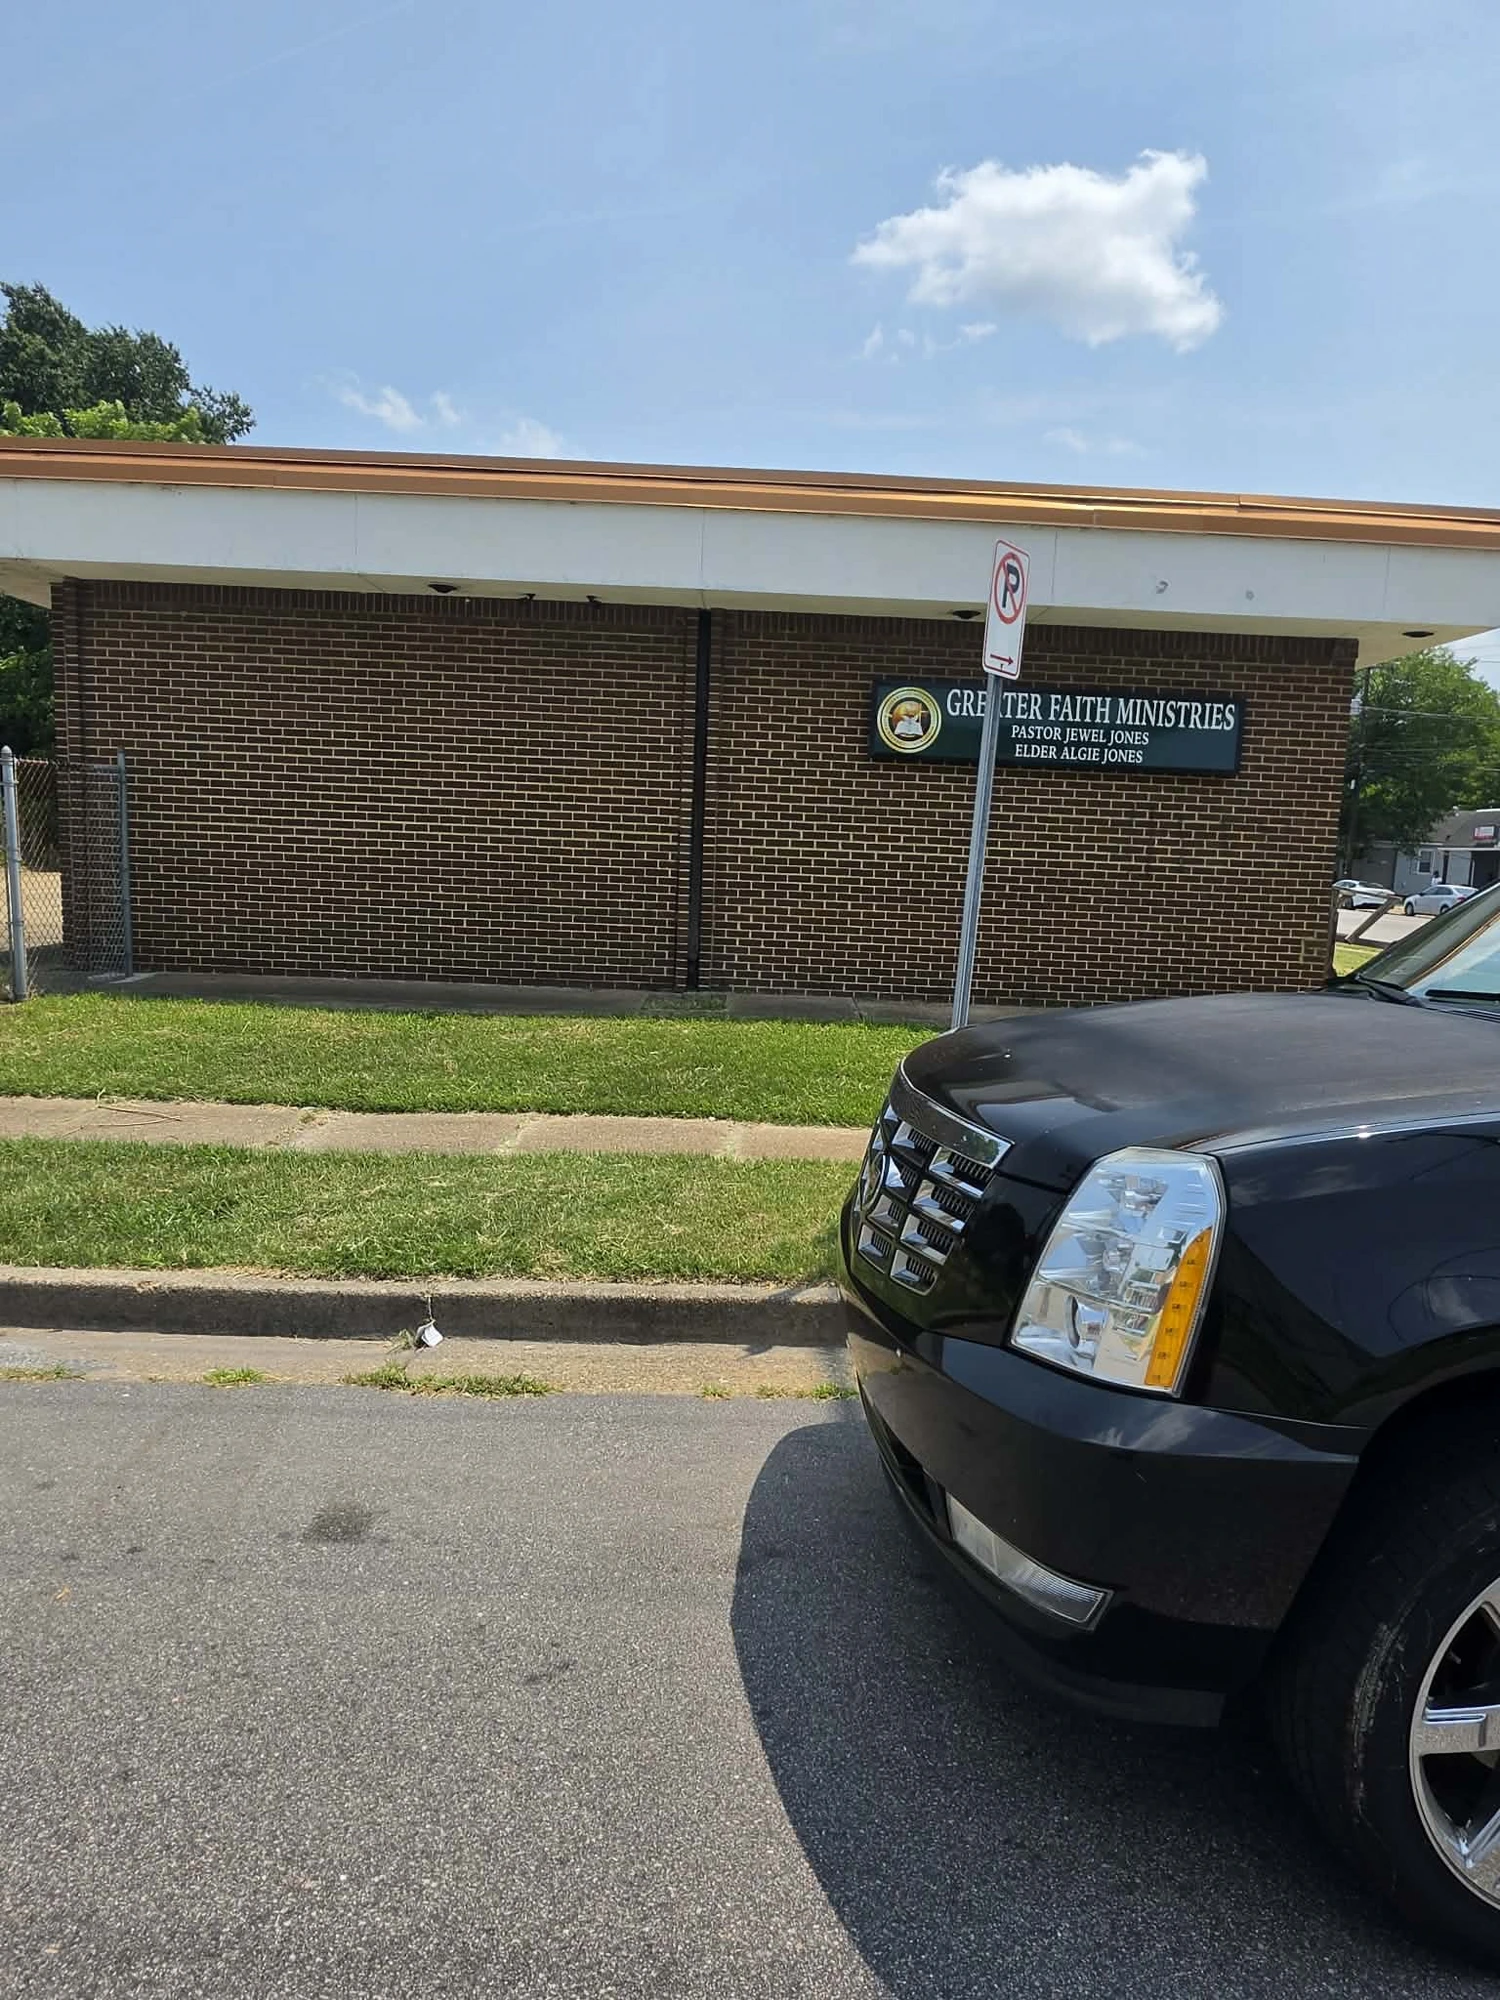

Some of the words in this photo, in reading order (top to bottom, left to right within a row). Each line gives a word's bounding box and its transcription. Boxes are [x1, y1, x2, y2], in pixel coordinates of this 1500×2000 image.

[1002, 562, 1020, 608] P
[946, 688, 1042, 720] GRETER
[1048, 694, 1111, 723] FAITH
[1115, 698, 1235, 730] MINISTRIES
[1011, 725, 1062, 741] PASTOR
[1063, 727, 1107, 744] JEWEL
[1107, 730, 1150, 746] JONES
[1015, 744, 1058, 759] ELDER
[1060, 746, 1101, 761] ALGIE
[1101, 748, 1143, 764] JONES
